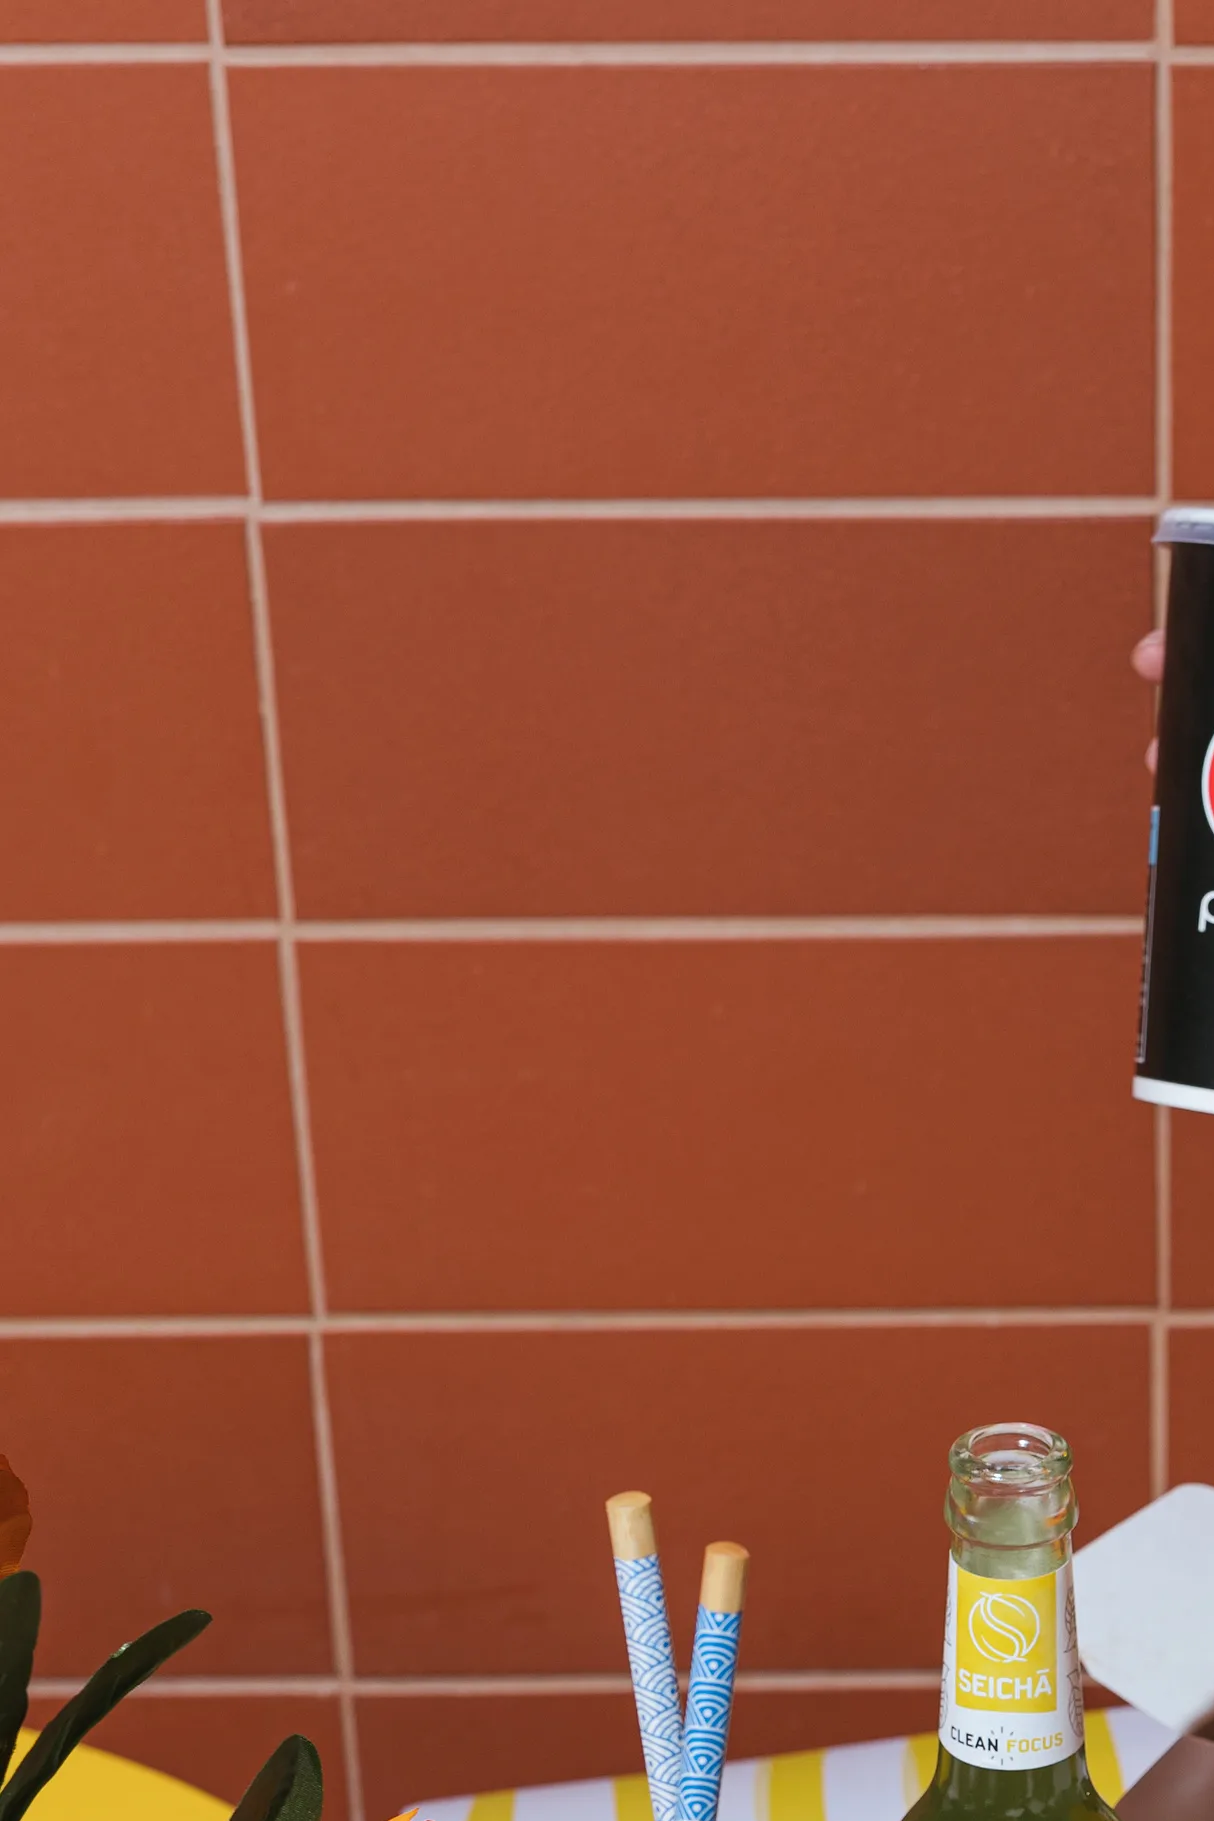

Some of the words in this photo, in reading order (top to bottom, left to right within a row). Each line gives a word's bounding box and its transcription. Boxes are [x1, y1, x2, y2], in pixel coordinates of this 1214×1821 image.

[958, 1668, 1052, 1700] SEICHĀ
[950, 1725, 999, 1752] CLEAN
[1006, 1732, 1064, 1753] FOCUS
